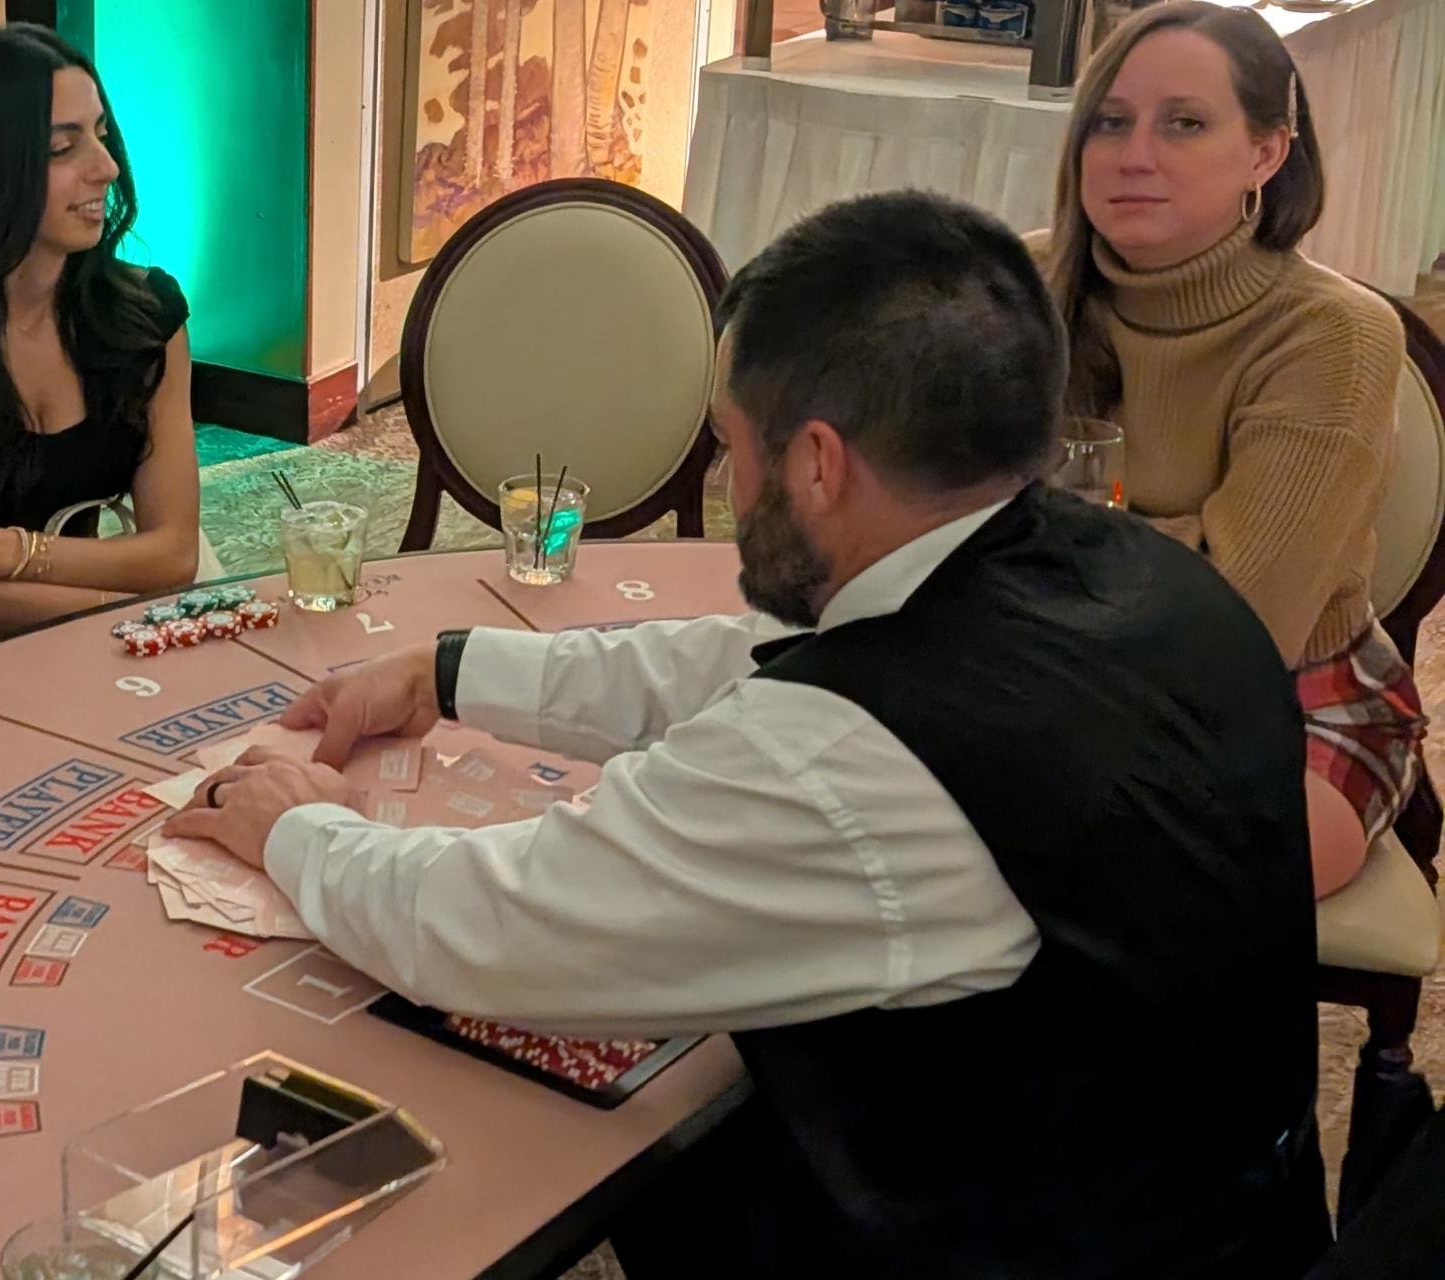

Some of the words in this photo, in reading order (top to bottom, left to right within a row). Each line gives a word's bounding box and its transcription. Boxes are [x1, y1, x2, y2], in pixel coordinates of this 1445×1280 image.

[616, 580, 655, 601] 8
[356, 613, 394, 633] 7
[115, 675, 162, 698] 6
[137, 687, 292, 749] PLAYER
[46, 787, 168, 855] BANK
